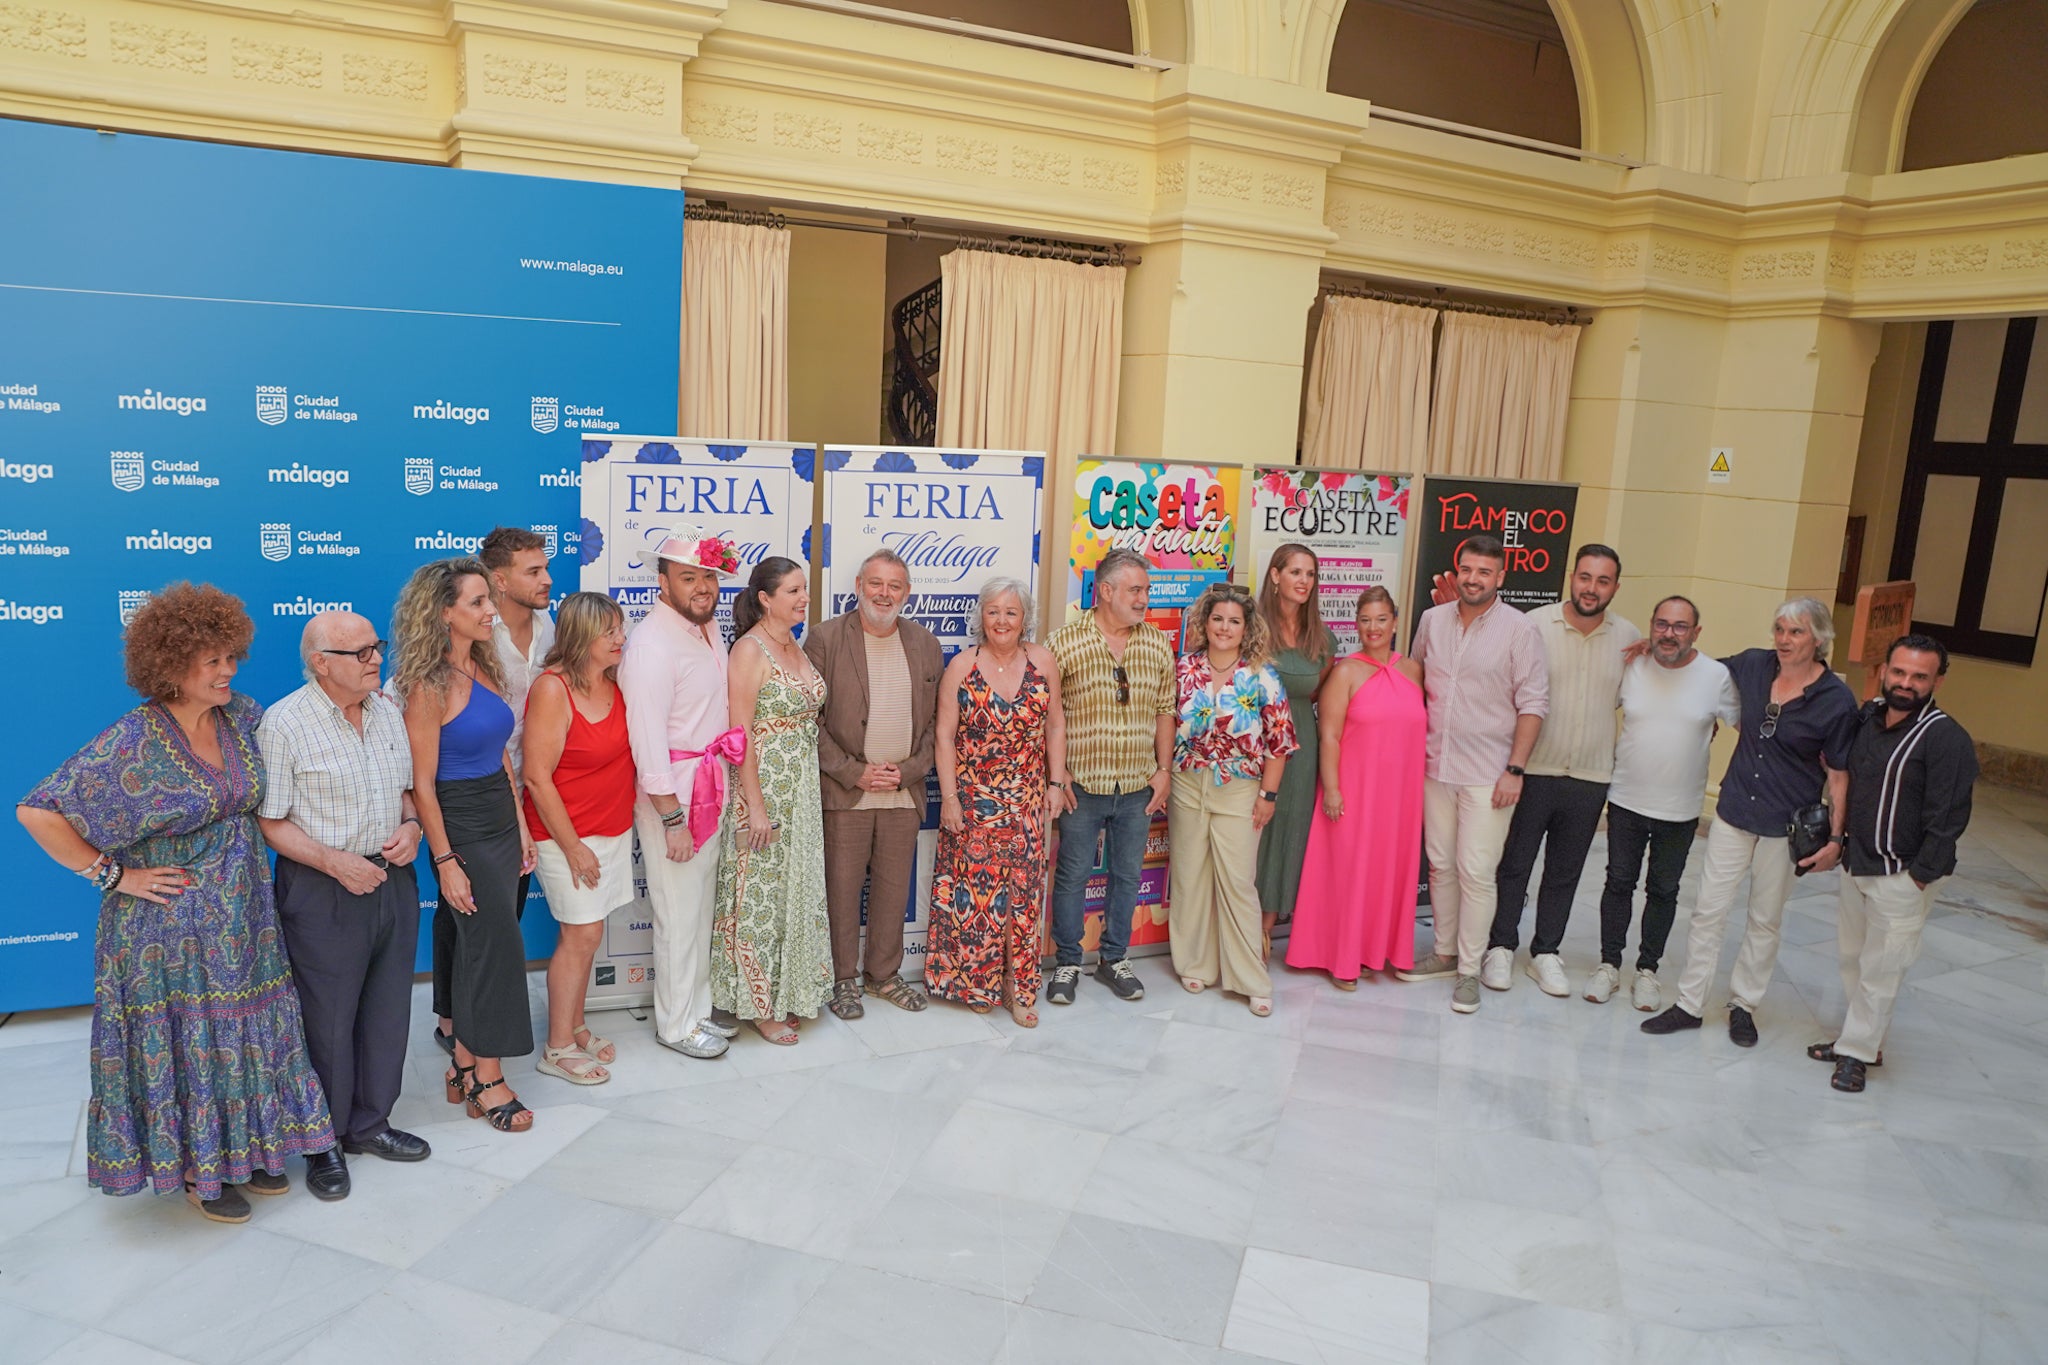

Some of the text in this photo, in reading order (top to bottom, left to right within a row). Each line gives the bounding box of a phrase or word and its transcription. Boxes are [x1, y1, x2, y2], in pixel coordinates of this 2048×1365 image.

[520, 258, 623, 276] www.malaga.eu
[0, 384, 38, 396] udad
[8, 398, 61, 414] Málaga
[294, 394, 339, 407] Ciudad
[295, 408, 358, 423] de Málaga
[564, 405, 604, 417] Ciudad
[564, 418, 620, 431] de Málaga
[0, 458, 54, 483] laga
[151, 460, 199, 472] Ciudad
[439, 466, 481, 478] Ciudad
[152, 474, 220, 488] de Málaga
[440, 479, 499, 492] de Málaga
[625, 473, 774, 516] FERIA
[864, 482, 1004, 520] FERIA
[1295, 488, 1376, 511] CASETA
[1438, 492, 1567, 534] FLAMENCO
[624, 519, 639, 530] de
[1264, 506, 1398, 536] ECUESTRE
[0, 529, 48, 541] Ciudad
[297, 530, 342, 541] Ciudad
[863, 524, 876, 534] de
[563, 532, 582, 542] Ciu
[1502, 530, 1524, 548] EL
[0, 543, 70, 557] de Málaga
[298, 544, 361, 557] de Málaga
[563, 544, 578, 554] de
[1453, 539, 1550, 573] CTRO
[901, 594, 979, 624] Municip
[1323, 600, 1356, 608] ARTUJAN
[629, 609, 731, 618] SÁB STO
[1321, 609, 1334, 618] STA
[940, 615, 959, 632] la
[629, 922, 653, 931] SÁBA
[0, 932, 79, 946] mientomalaga
